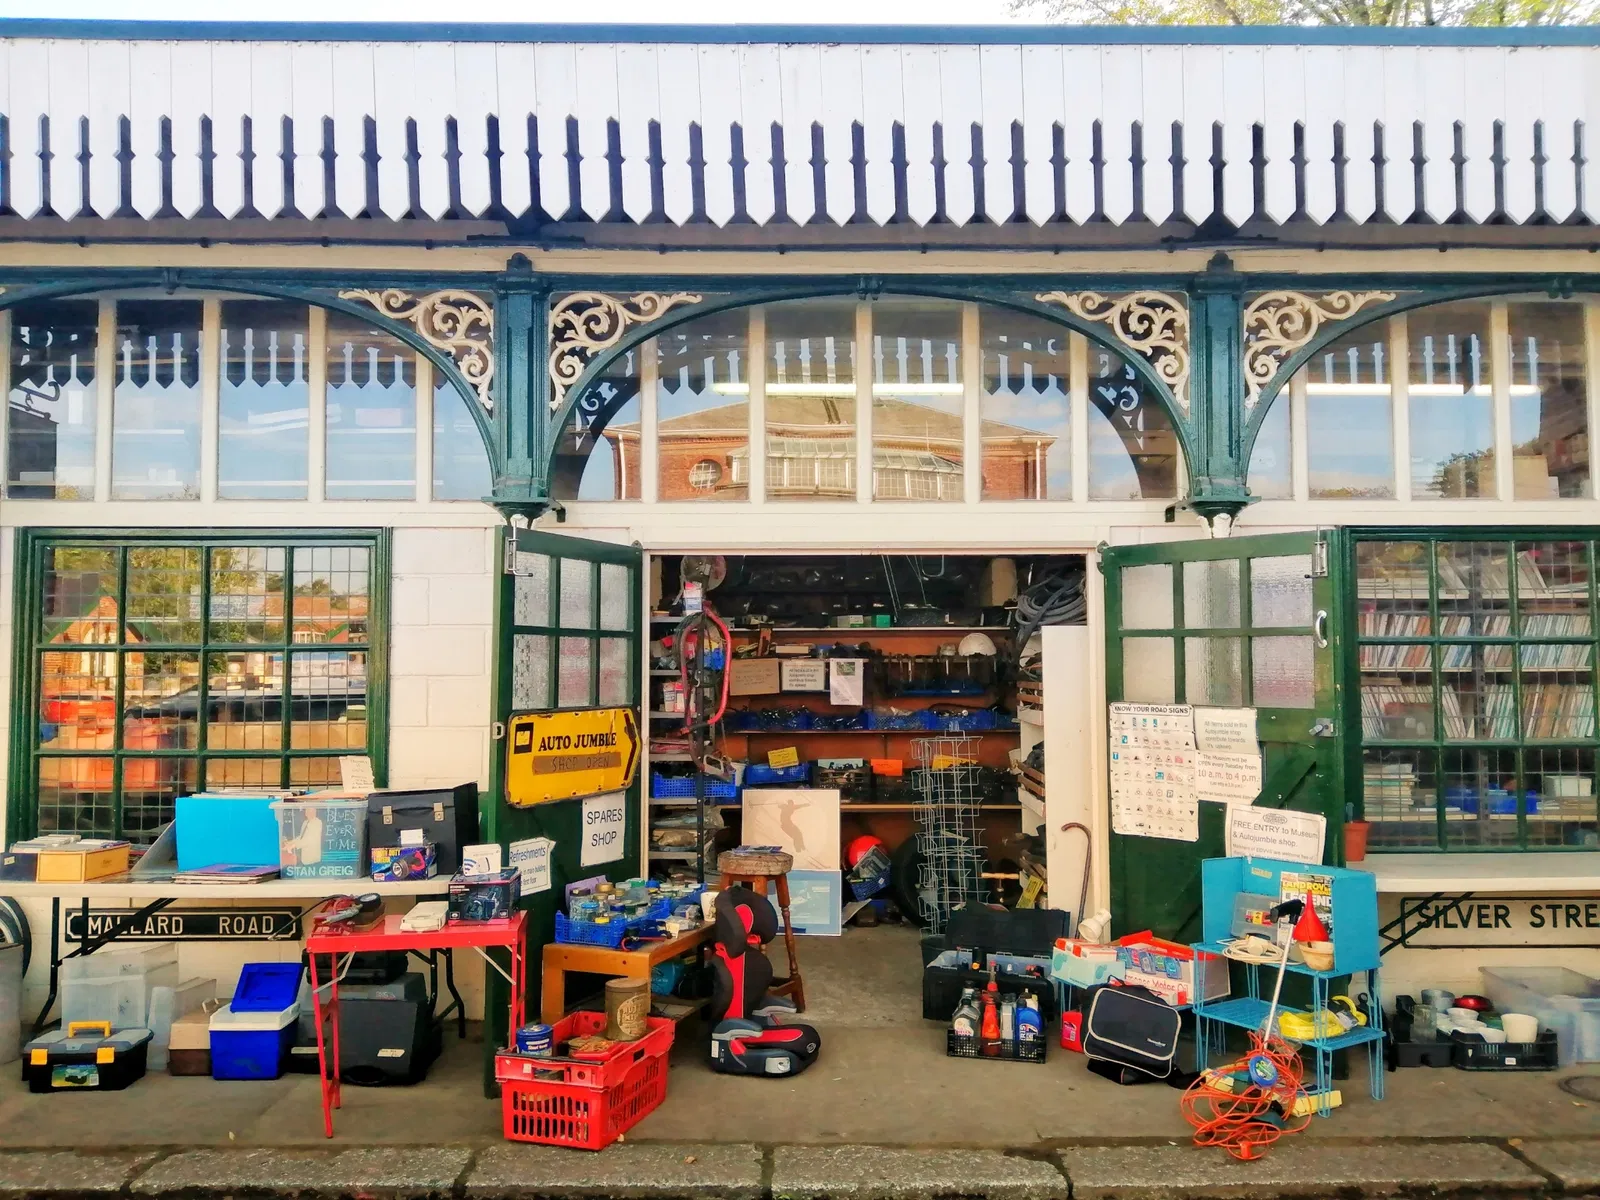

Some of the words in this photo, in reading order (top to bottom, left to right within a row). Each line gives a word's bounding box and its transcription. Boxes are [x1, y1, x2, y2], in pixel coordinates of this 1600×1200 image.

[538, 735, 571, 752] AUTO
[573, 732, 617, 749] JUMBLE
[551, 756, 578, 771] SHOP
[586, 756, 610, 769] OPEN
[1197, 769, 1207, 777] 10
[1208, 771, 1224, 779] a.m.
[1225, 771, 1233, 780] to
[326, 807, 357, 823] BLUES
[586, 808, 623, 825] SPARES
[1233, 820, 1252, 830] FREE
[1253, 823, 1280, 834] ENTRY
[1290, 828, 1319, 839] Museum
[591, 830, 617, 847] SHOP
[1239, 832, 1278, 845] Autojumble
[510, 847, 546, 863] Refreshments
[286, 865, 316, 877] STAN
[318, 864, 354, 876] GREIG
[1282, 880, 1306, 891] LAND
[1417, 903, 1513, 929] SILVER
[219, 915, 274, 935] ROAD
[1152, 979, 1176, 992] Motor
